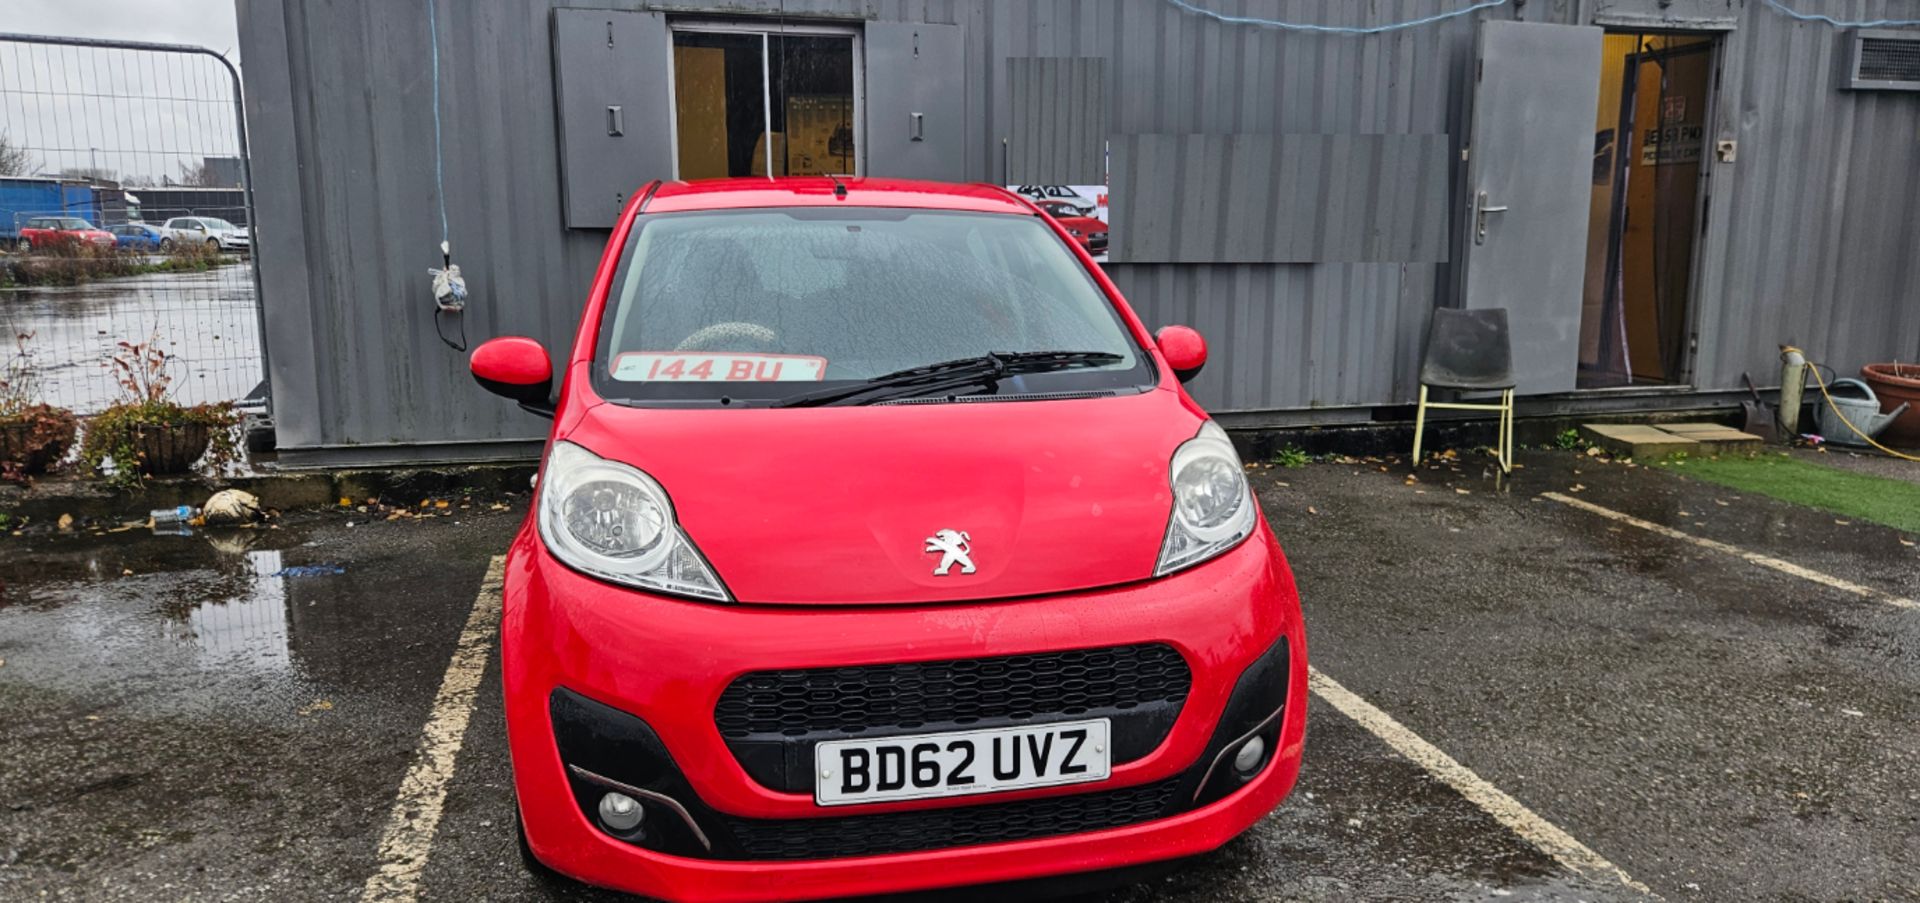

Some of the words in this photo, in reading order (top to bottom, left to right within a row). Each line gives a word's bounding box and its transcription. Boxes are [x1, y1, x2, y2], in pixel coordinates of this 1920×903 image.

[647, 359, 713, 380] 144
[725, 360, 783, 382] BU
[840, 740, 975, 794] BD62
[992, 729, 1087, 781] UVZ
